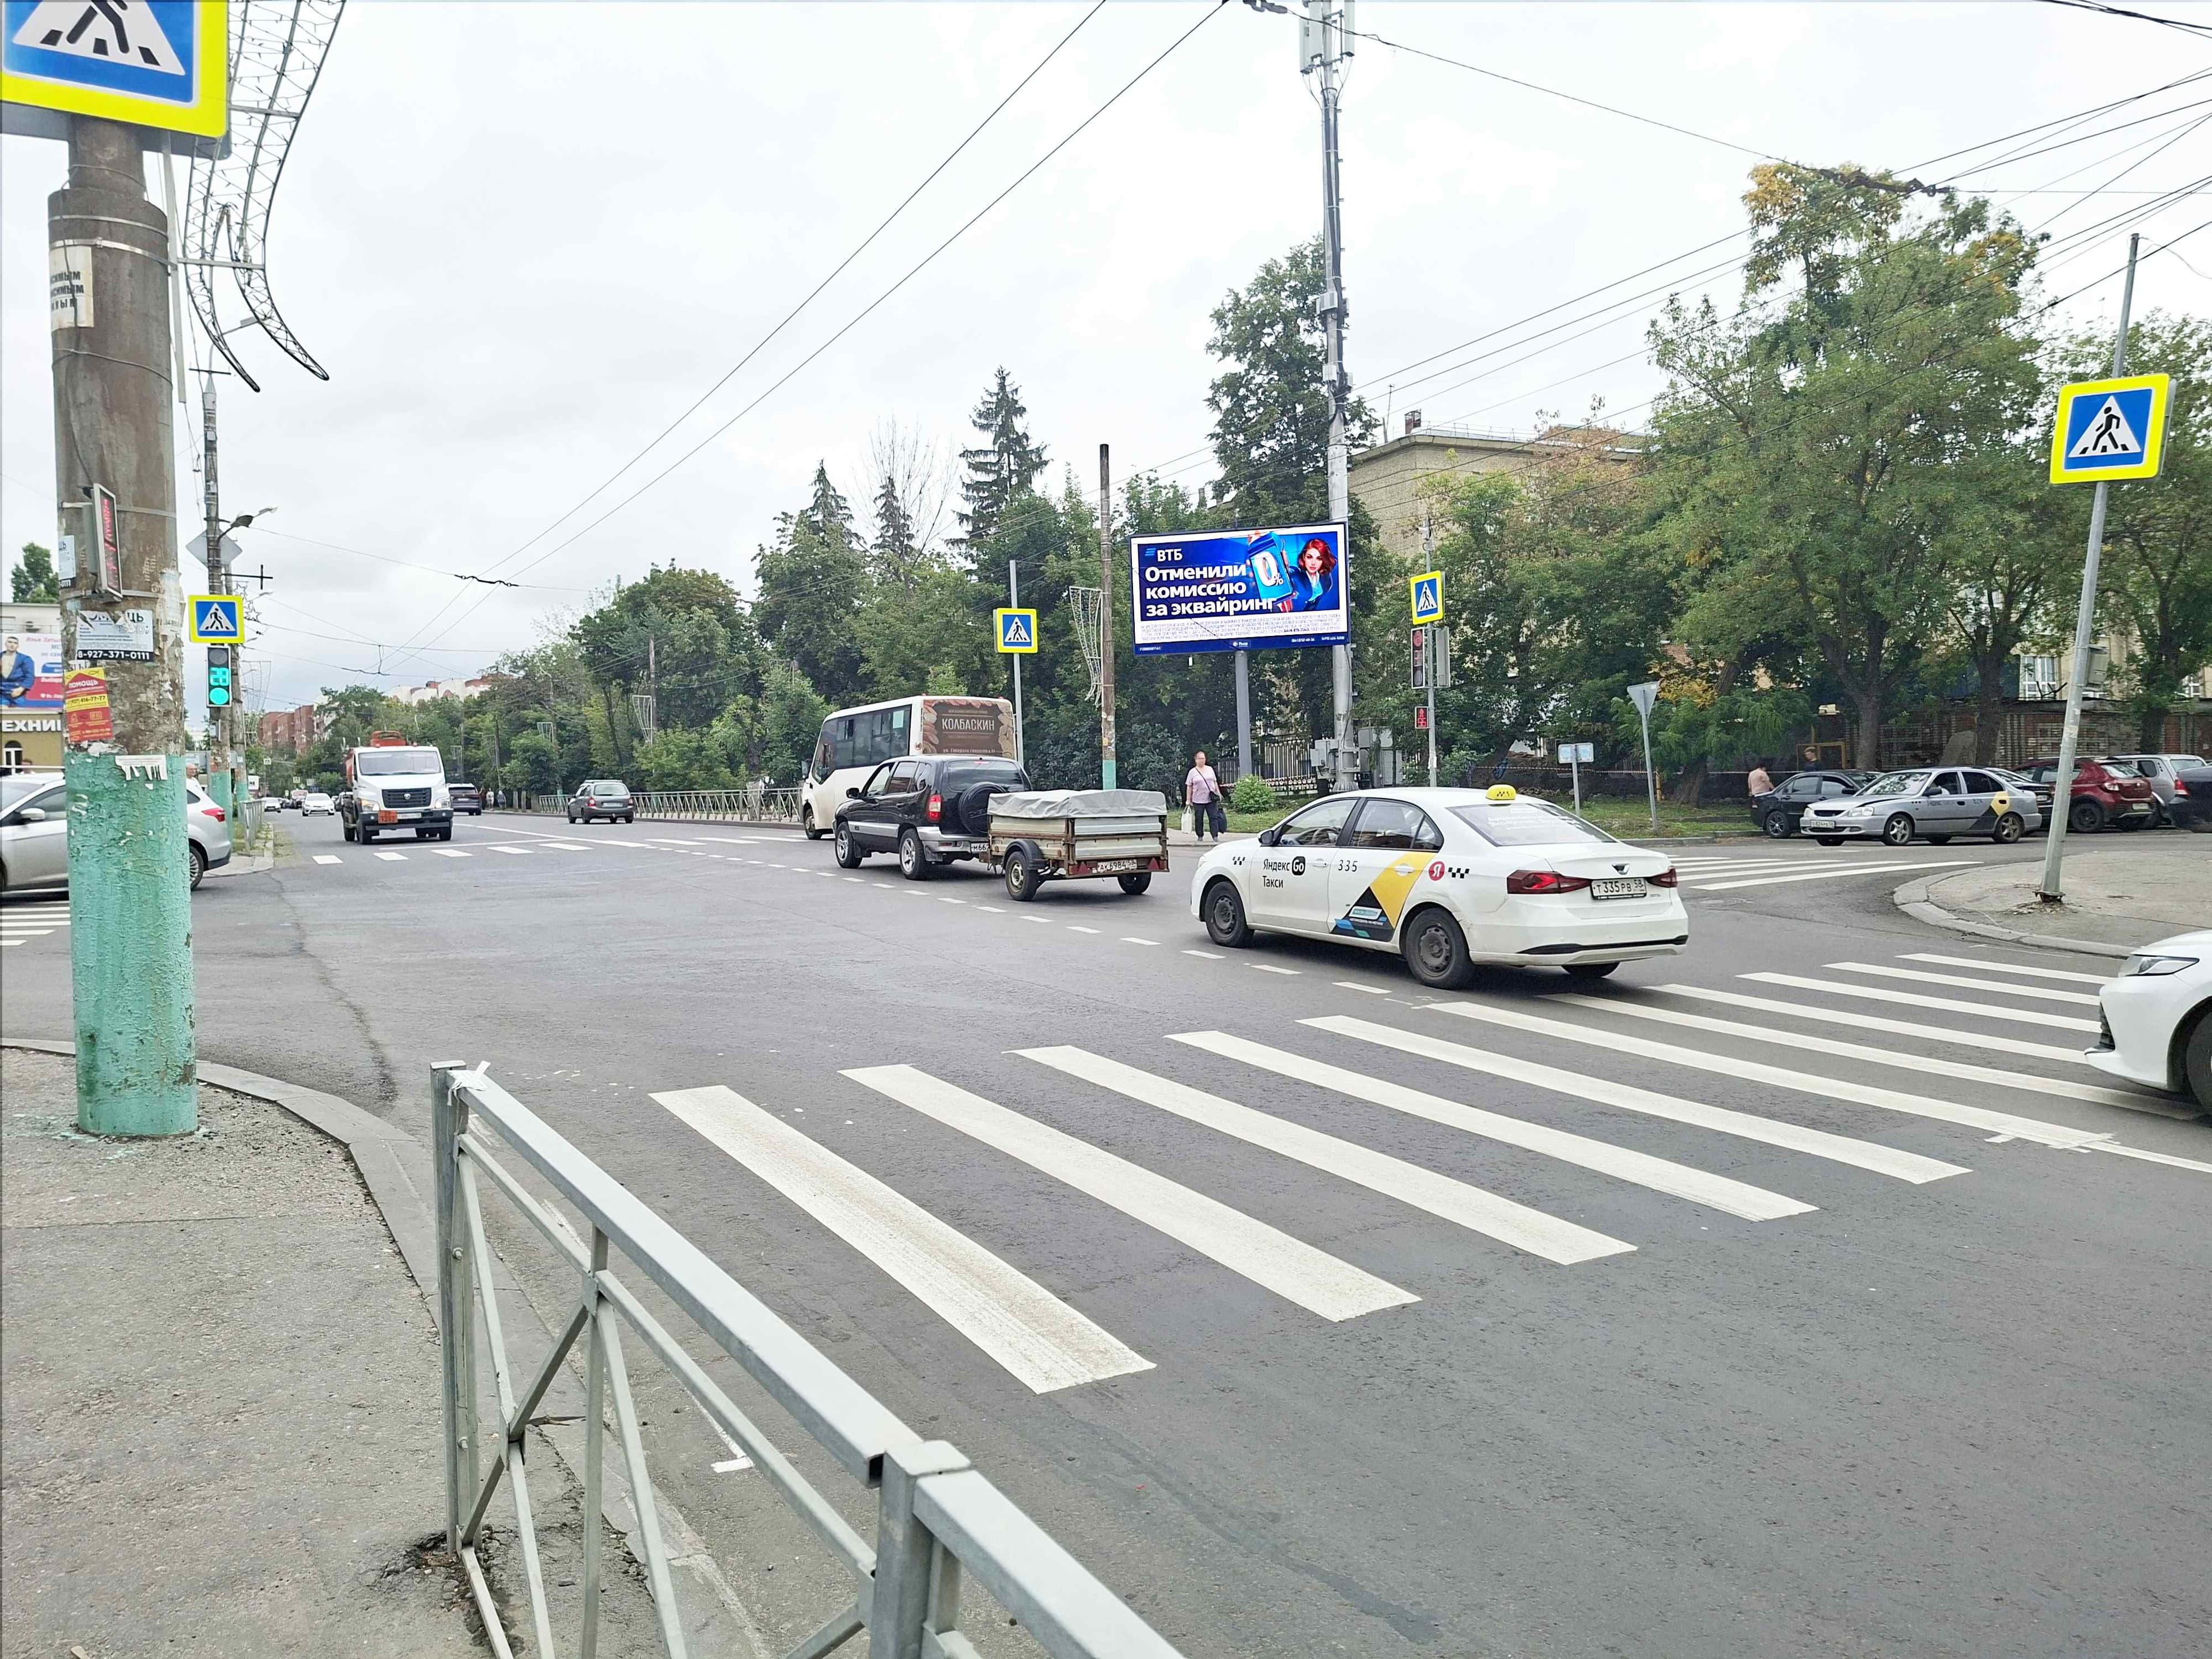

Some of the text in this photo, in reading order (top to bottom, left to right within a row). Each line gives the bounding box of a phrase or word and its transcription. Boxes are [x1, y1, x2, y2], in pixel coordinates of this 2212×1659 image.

[1157, 548, 1183, 562] ВТБ
[1145, 564, 1247, 582] Отменили
[1254, 551, 1284, 586] 0%
[1146, 582, 1247, 599] комиссию
[1146, 597, 1277, 616] за эквайринг
[77, 650, 150, 660] 8-927-371-0111
[0, 719, 62, 732] ЕХНИ
[942, 718, 995, 731] КОЛБАСКИН
[1263, 858, 1290, 872] Яндекс
[1293, 859, 1305, 872] Go
[1338, 859, 1358, 872] 335
[1262, 876, 1283, 888] Такси
[1633, 880, 1642, 888] 58
